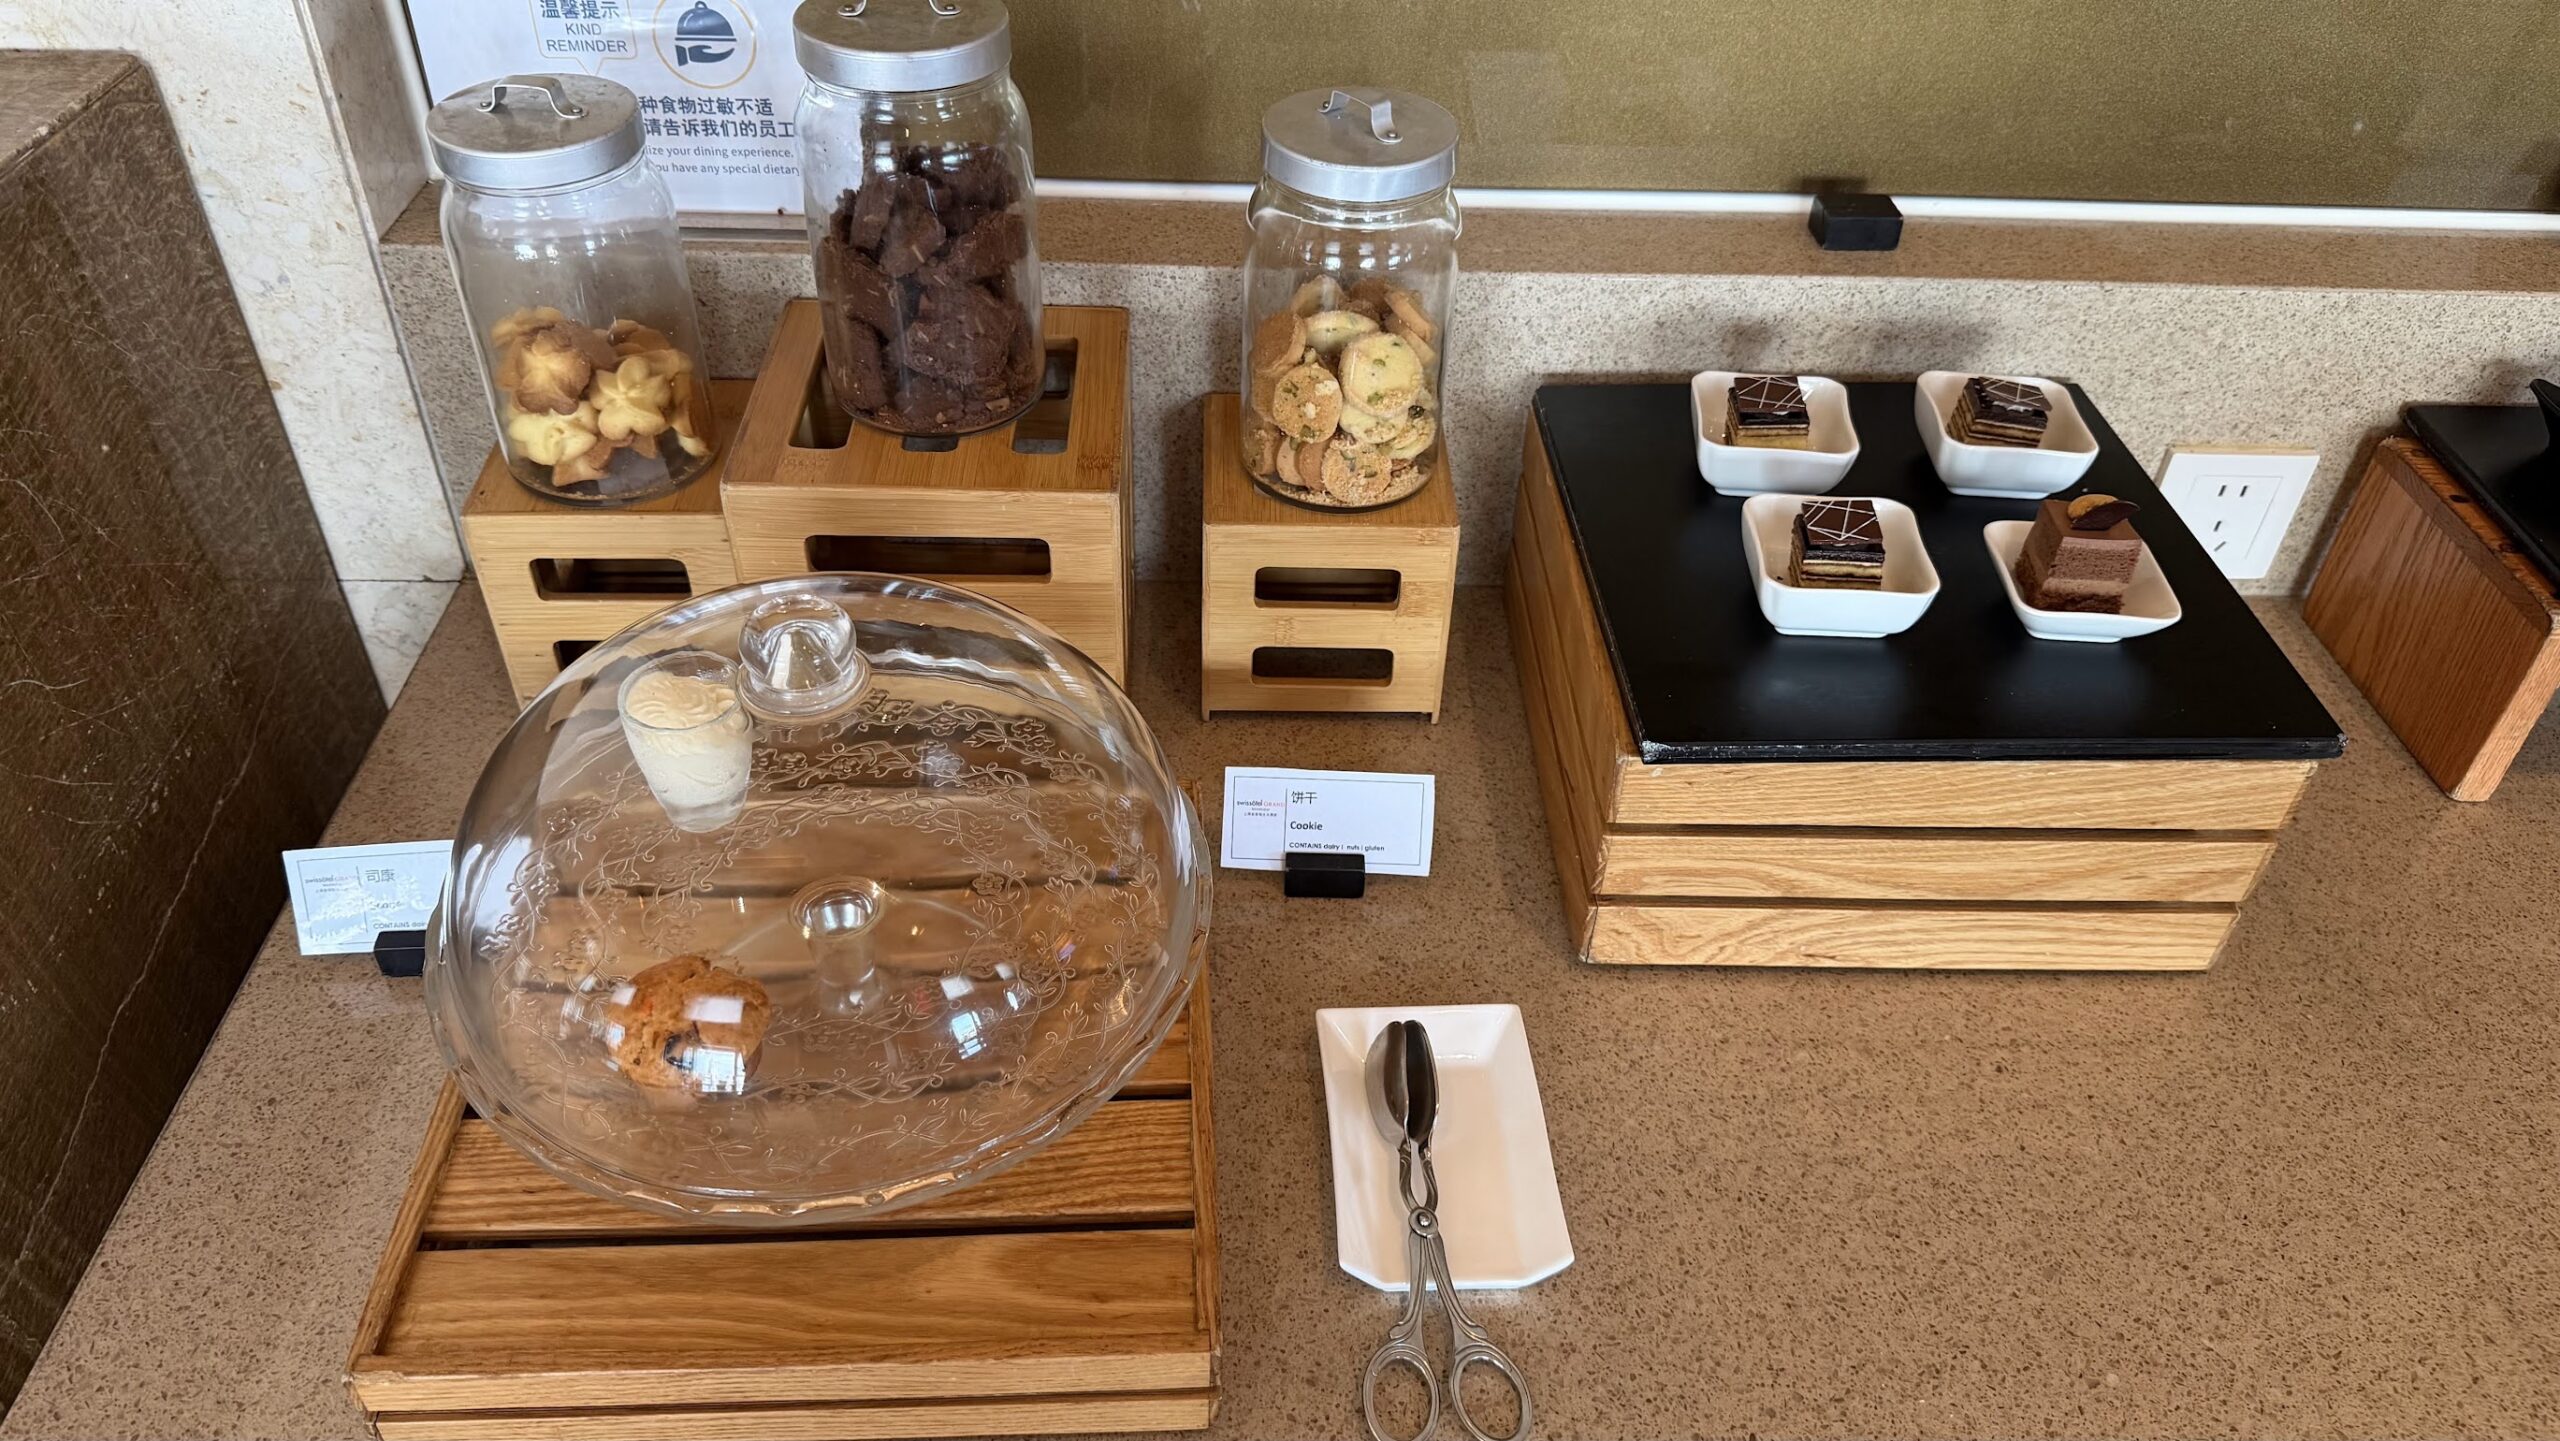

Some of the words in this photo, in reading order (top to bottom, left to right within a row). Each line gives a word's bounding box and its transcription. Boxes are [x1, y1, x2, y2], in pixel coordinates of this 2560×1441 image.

[541, 0, 620, 19] 温馨提示
[565, 23, 602, 36] KIND
[546, 39, 628, 53] REMINDER
[667, 147, 691, 157] your
[694, 146, 729, 159] dining
[731, 148, 794, 158] experience.
[672, 163, 698, 173] have
[700, 165, 720, 176] any
[723, 164, 761, 176] special
[1291, 790, 1318, 805] 饼干
[1290, 820, 1323, 831] Cookie
[1323, 843, 1340, 851] dairy
[365, 869, 395, 883] 司康
